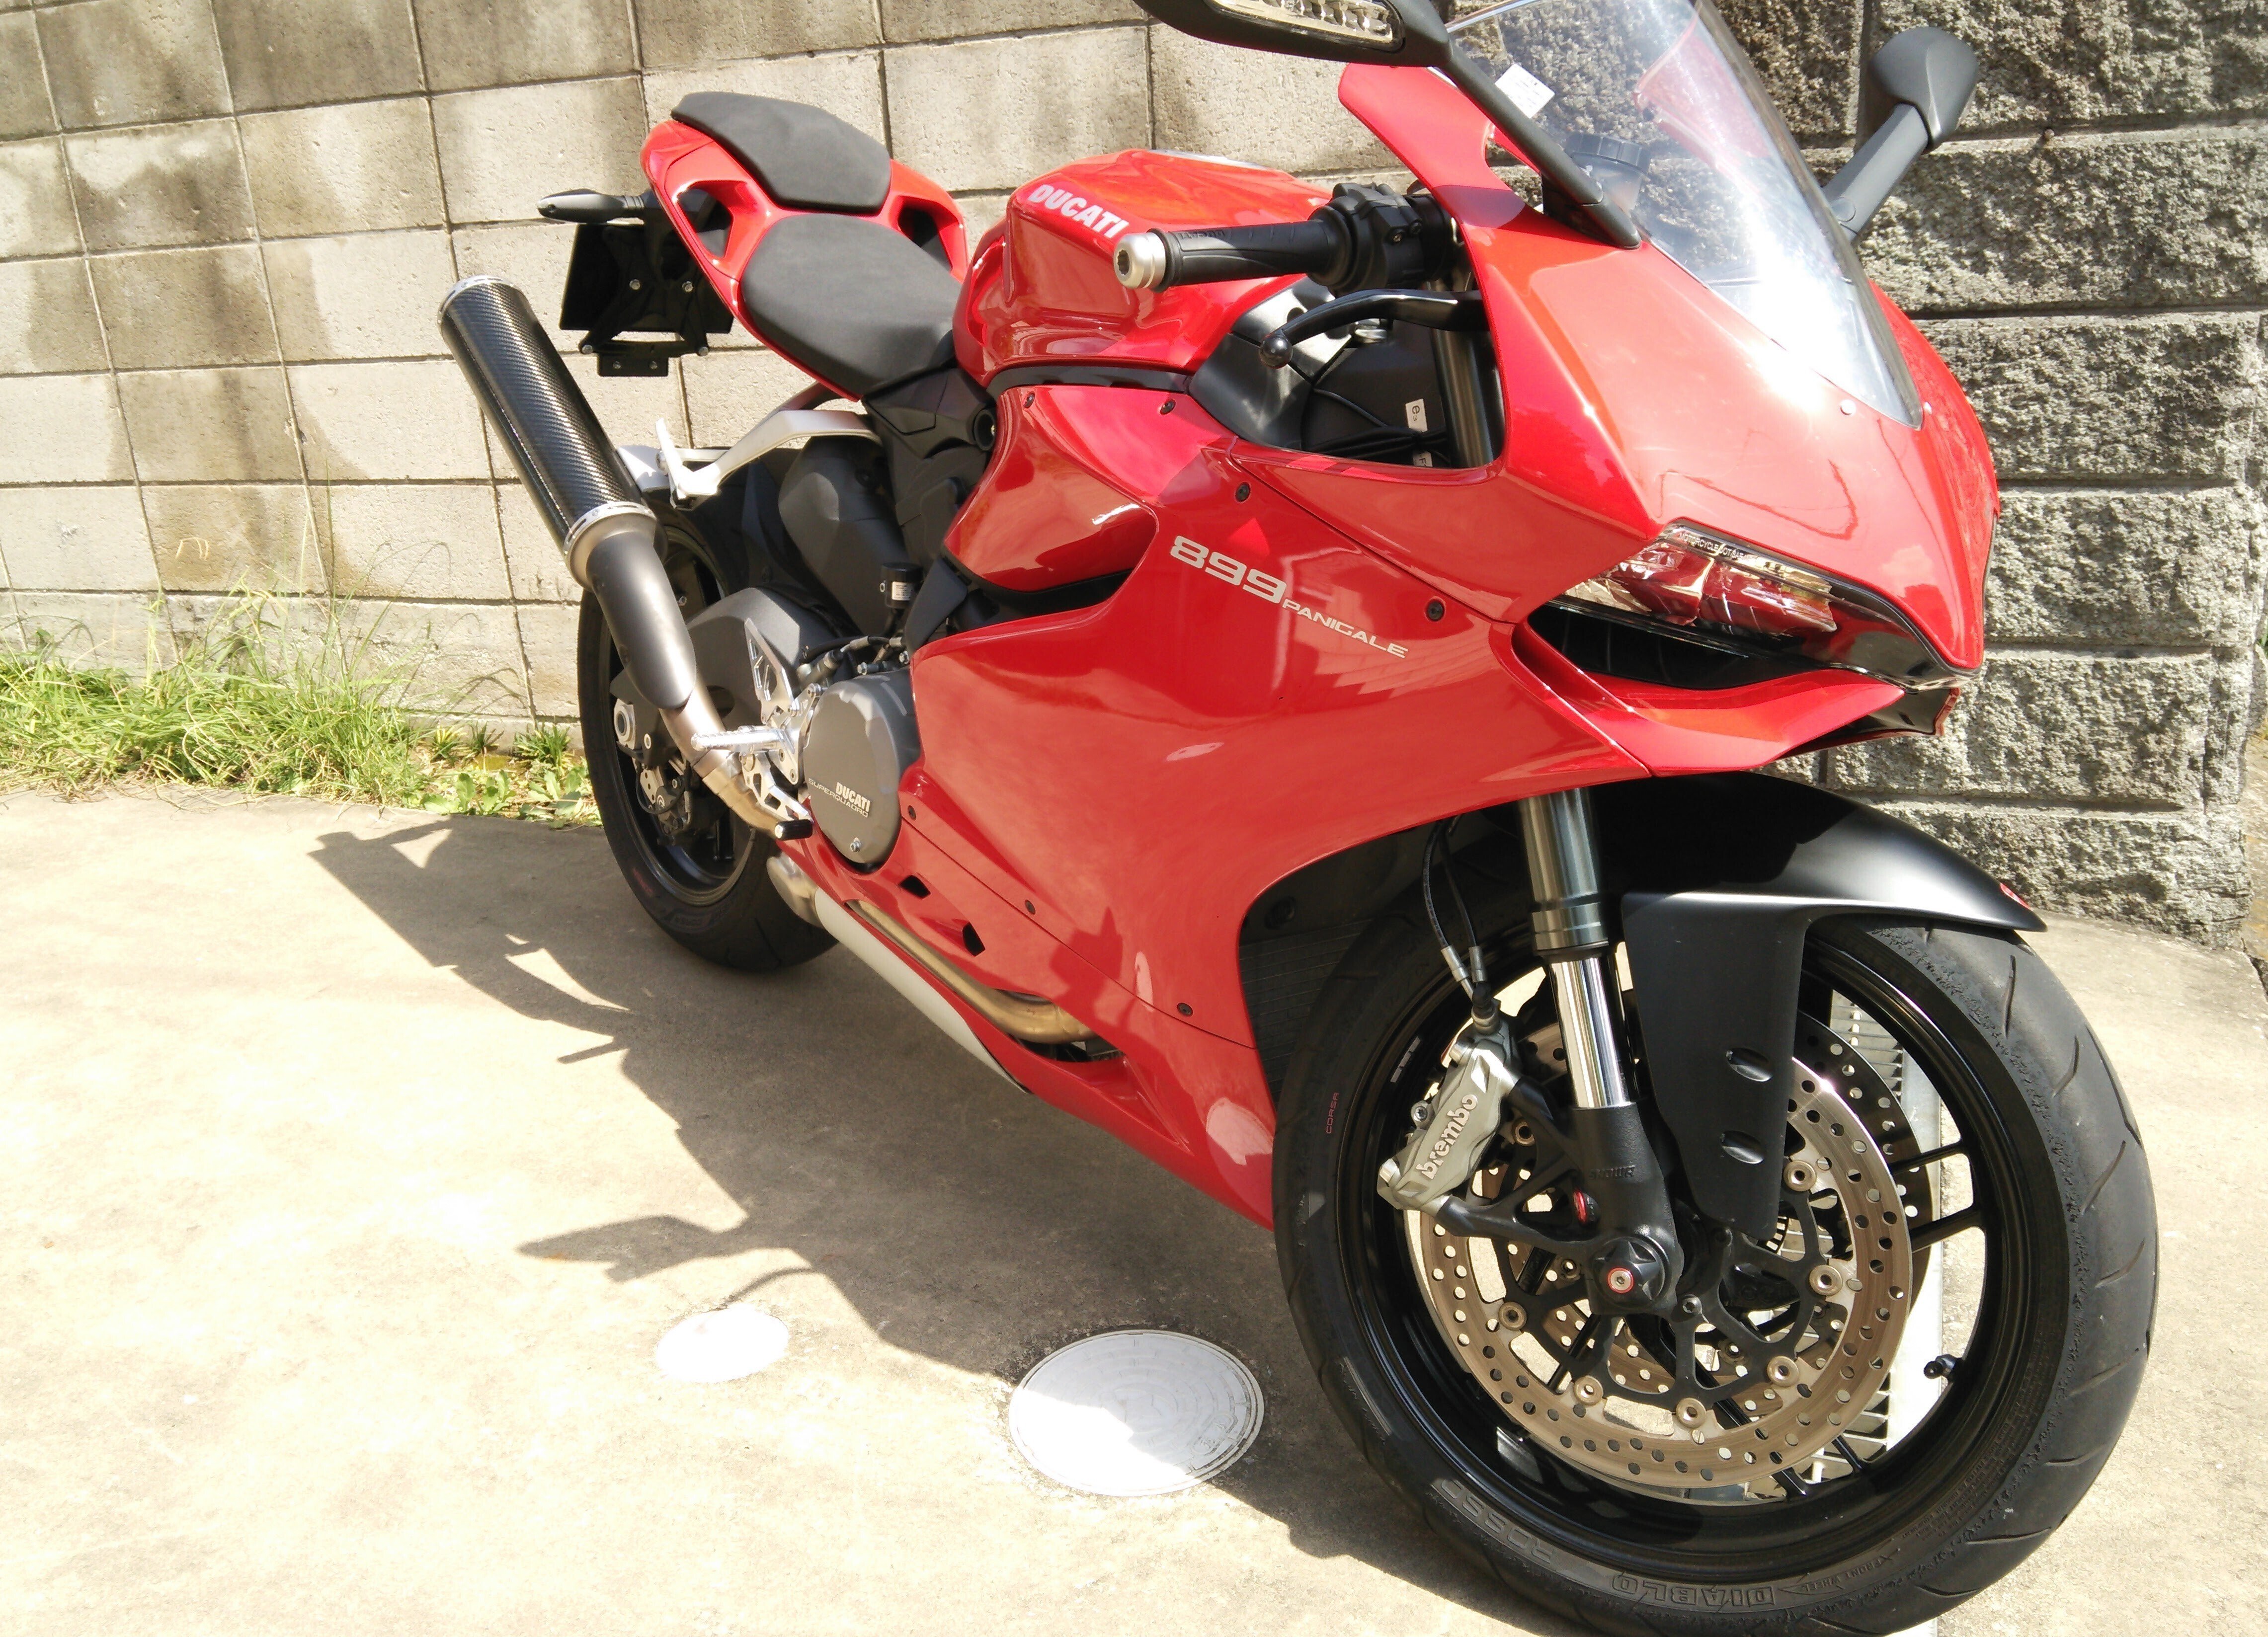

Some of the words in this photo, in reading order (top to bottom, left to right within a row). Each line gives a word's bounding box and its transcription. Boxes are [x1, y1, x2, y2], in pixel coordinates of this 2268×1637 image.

[1028, 184, 1130, 238] DUCATI
[1679, 532, 1719, 551] MOTORCYCLE
[1170, 535, 1288, 604] 899
[1282, 598, 1409, 659] PANIGALE
[808, 778, 869, 818] SUPERQUADRO
[835, 781, 871, 812] DUCATI
[1325, 1091, 1340, 1134] CORSA
[1415, 1093, 1478, 1179] brembo
[1440, 1478, 1554, 1564] ROSSO
[1612, 1574, 1776, 1608] DIABLO
